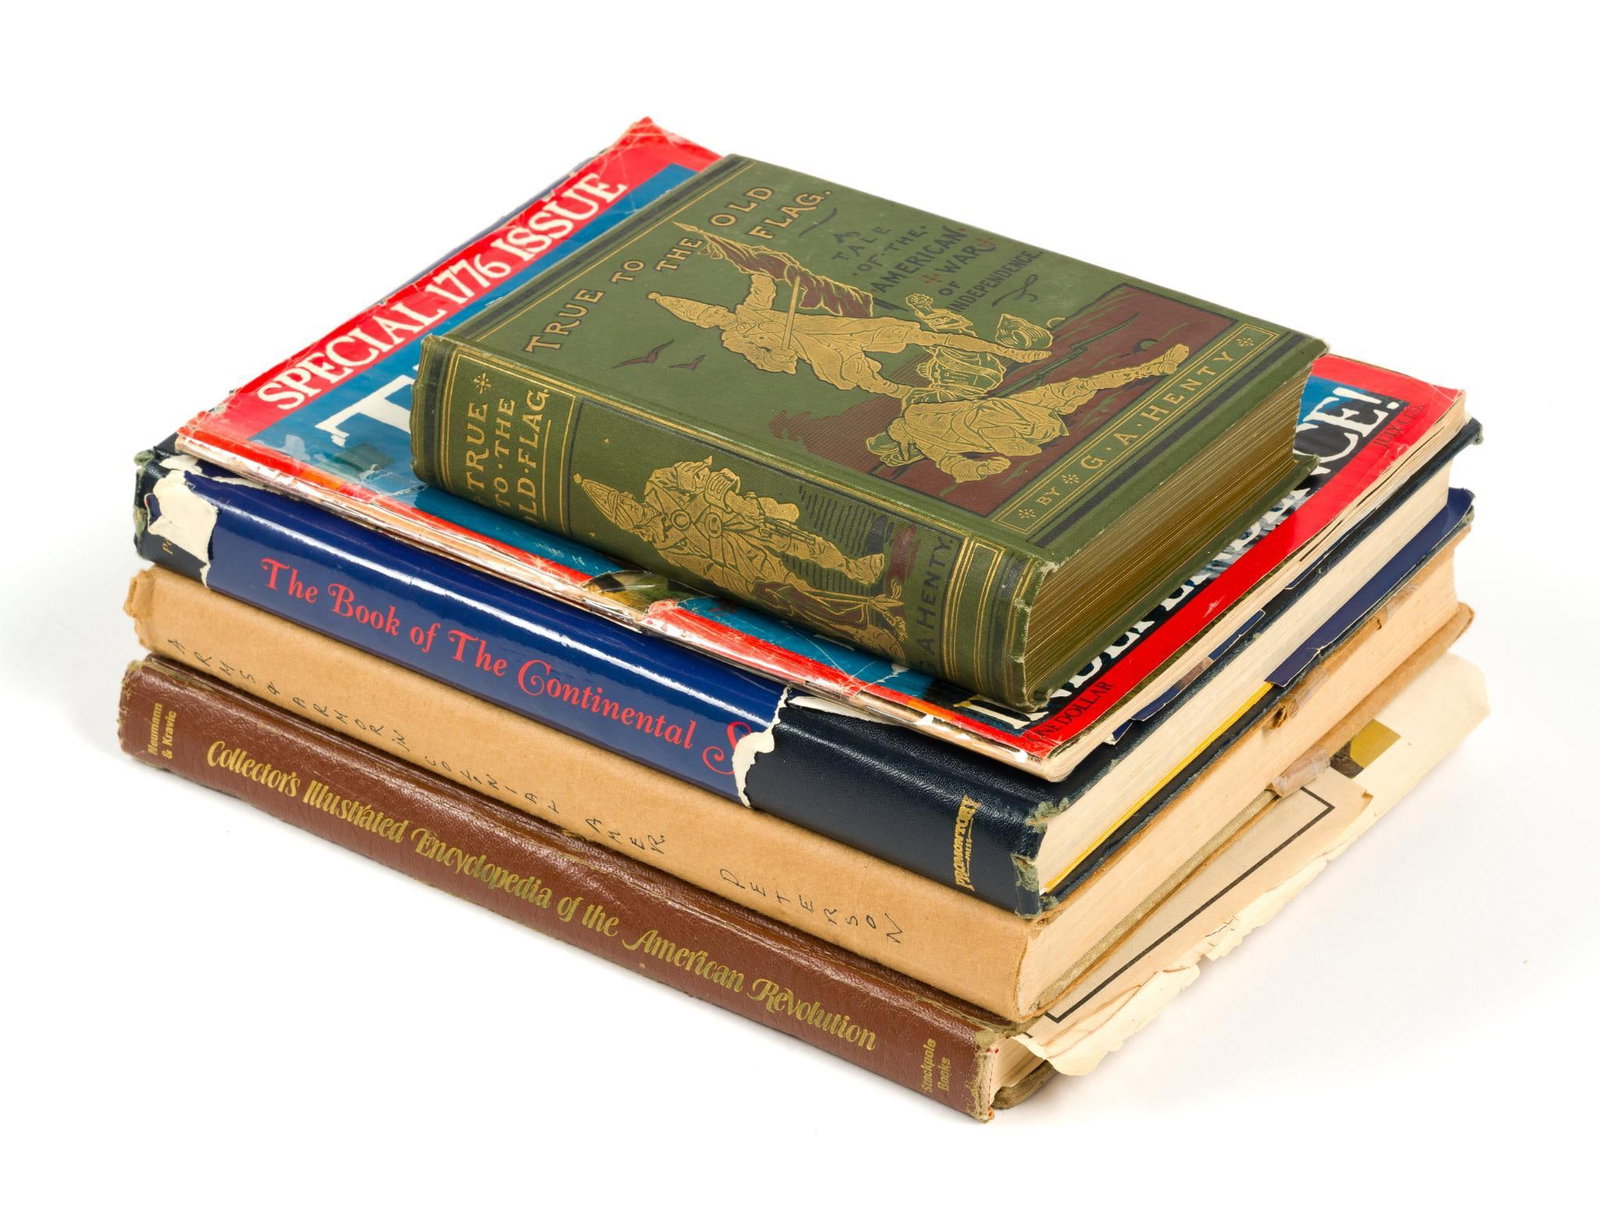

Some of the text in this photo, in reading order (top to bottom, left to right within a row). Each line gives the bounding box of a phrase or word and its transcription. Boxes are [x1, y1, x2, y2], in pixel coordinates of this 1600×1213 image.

[708, 186, 775, 228] OLD
[745, 190, 832, 240] FLAG.
[655, 237, 703, 273] THE
[831, 226, 892, 261] TALE
[934, 240, 998, 275] WAR
[257, 173, 628, 410] SPECIAL 1776 ISSUE
[524, 259, 646, 353] TRUE TO
[938, 280, 961, 297] OF
[945, 250, 1044, 312] INDEPENDENCE.
[465, 401, 490, 491] TRUE
[1036, 486, 1061, 506] BY
[1139, 351, 1235, 422] HENTY
[517, 477, 539, 523] LD
[260, 557, 319, 604] The
[327, 583, 401, 637] Book
[409, 622, 441, 653] of
[447, 629, 508, 677] The
[517, 659, 697, 750] Continental
[147, 702, 163, 756] Neumann
[1059, 681, 1114, 726] DOLLAR
[162, 710, 177, 760] & Kravic
[167, 637, 256, 684] ARMS
[292, 695, 384, 737] ARMOR
[720, 869, 904, 945] PETERSON
[954, 794, 982, 892] PROMONTORY
[206, 740, 876, 1052] Collector's Illustrated Encyclopedia of the American Revolution
[921, 1038, 936, 1093] Stackpole
[937, 1056, 951, 1092] Books
